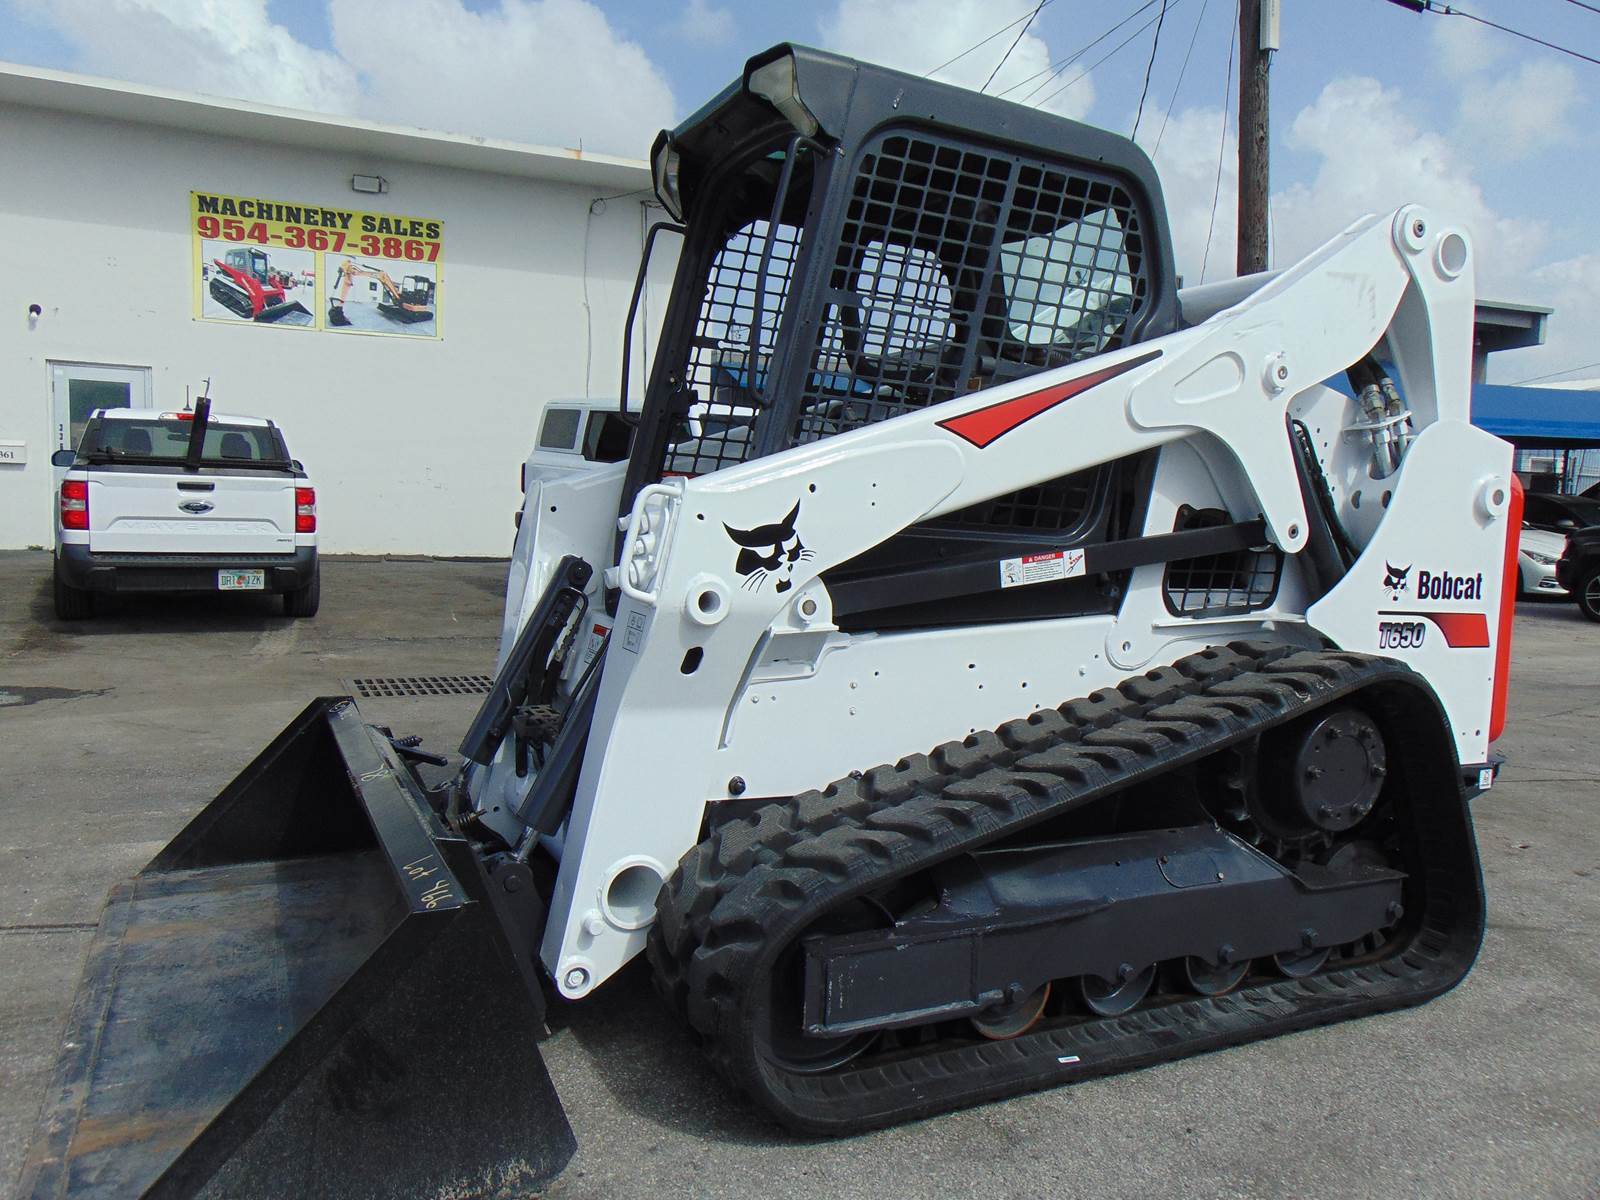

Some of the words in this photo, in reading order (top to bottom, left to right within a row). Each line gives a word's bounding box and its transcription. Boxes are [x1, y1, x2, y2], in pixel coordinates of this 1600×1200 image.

[197, 195, 353, 230] MACHINERY
[361, 215, 441, 239] SALES
[197, 215, 441, 262] 954-367-3867
[1033, 553, 1056, 563] DANGER
[1417, 570, 1482, 600] Bobcat
[1379, 622, 1426, 648] T650
[420, 879, 454, 910] 466
